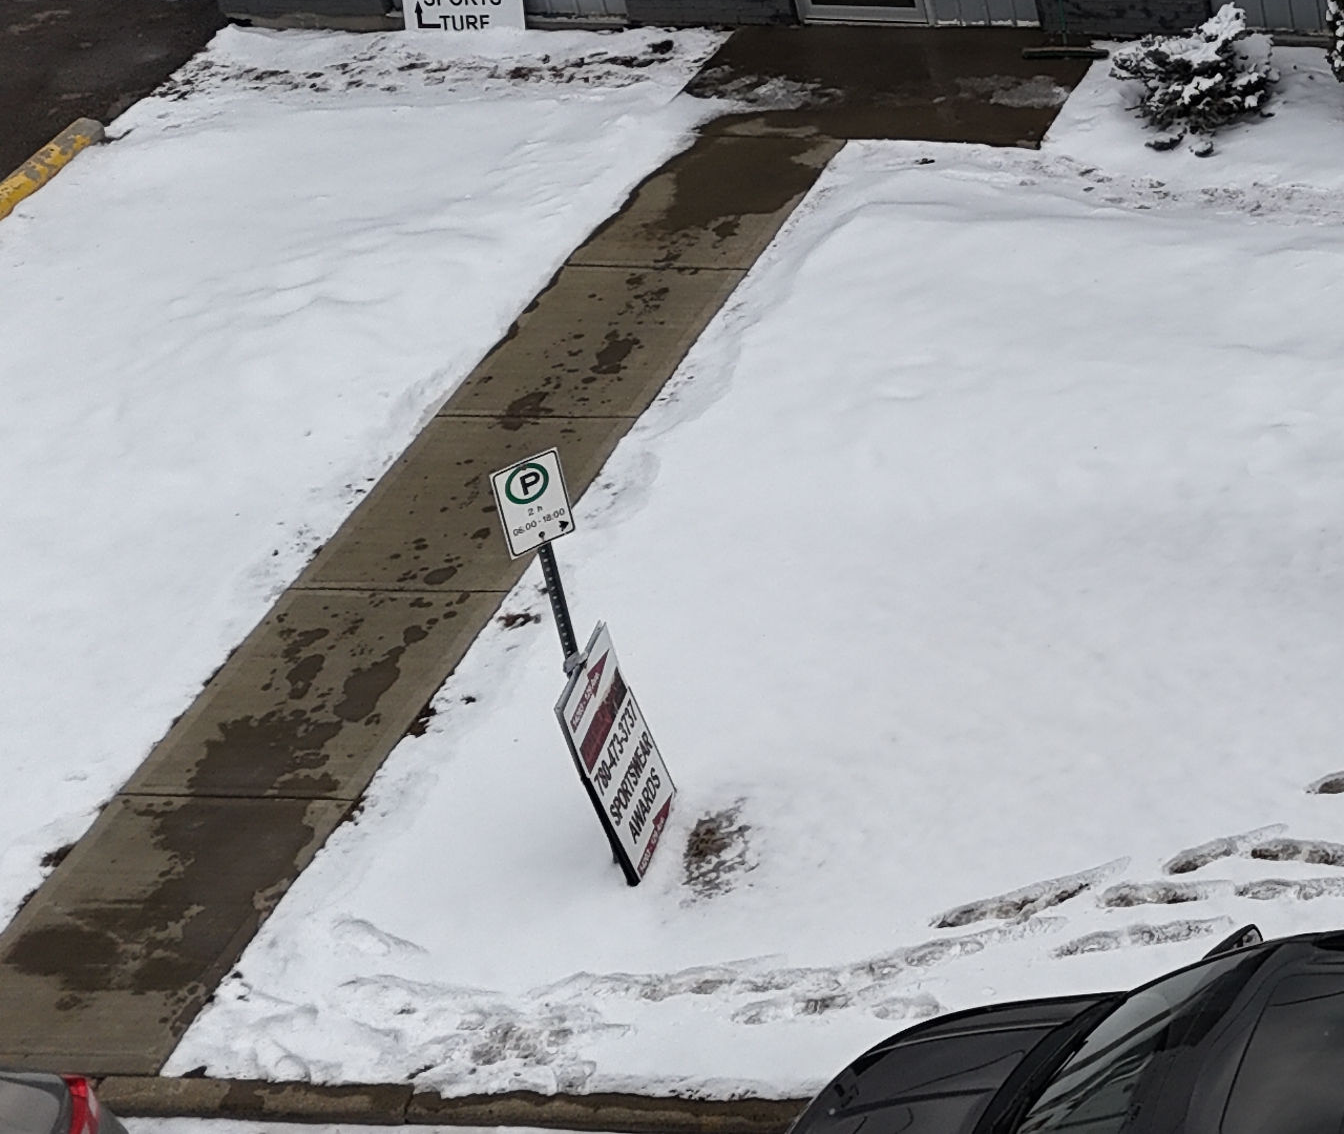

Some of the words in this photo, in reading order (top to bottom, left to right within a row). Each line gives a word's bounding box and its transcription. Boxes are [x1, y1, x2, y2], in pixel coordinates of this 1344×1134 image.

[439, 15, 490, 31] TURF
[520, 471, 540, 496] P
[527, 507, 535, 516] 2
[543, 508, 565, 523] 18:00
[593, 698, 638, 797] 780-473-3737
[609, 731, 653, 826] SPORTSWEAR
[628, 767, 661, 845] AWARDS
